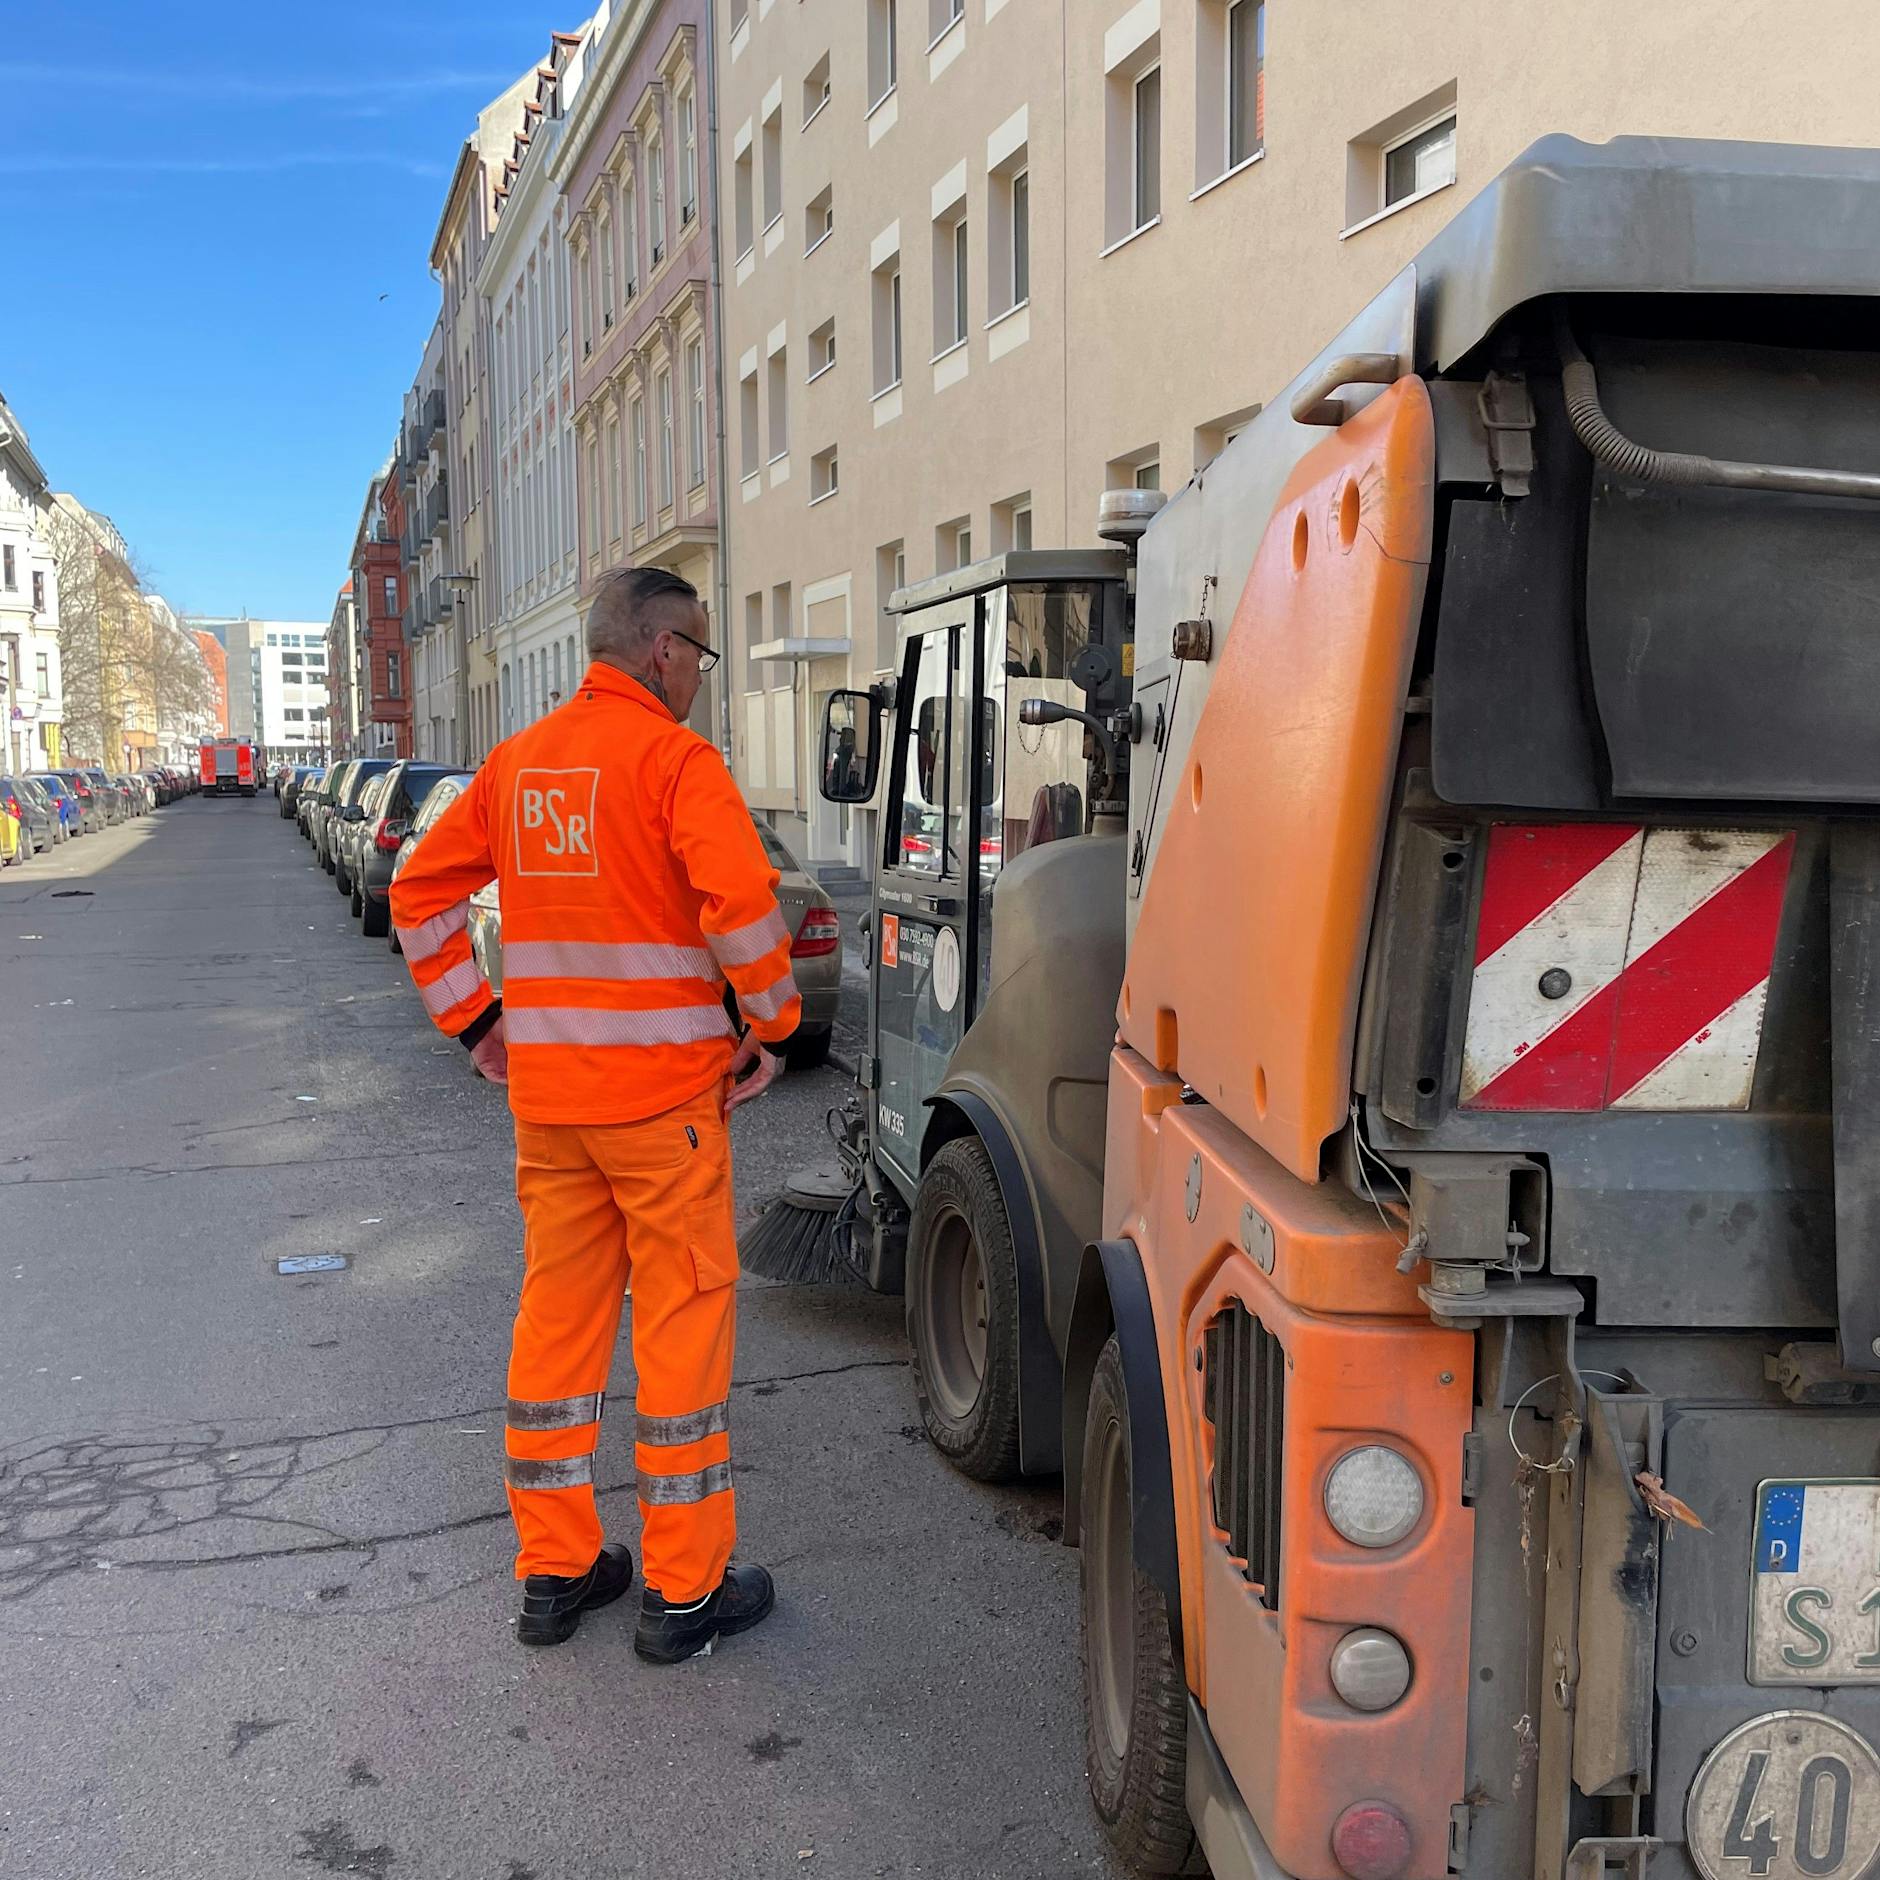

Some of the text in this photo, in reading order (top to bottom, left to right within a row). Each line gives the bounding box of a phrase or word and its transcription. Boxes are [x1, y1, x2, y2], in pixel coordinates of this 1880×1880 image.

[523, 788, 590, 855] BSR
[1513, 1041, 1530, 1056] 3M
[879, 1103, 905, 1137] KW 335
[1770, 1539, 1787, 1566] D
[1720, 1750, 1853, 1877] 40
